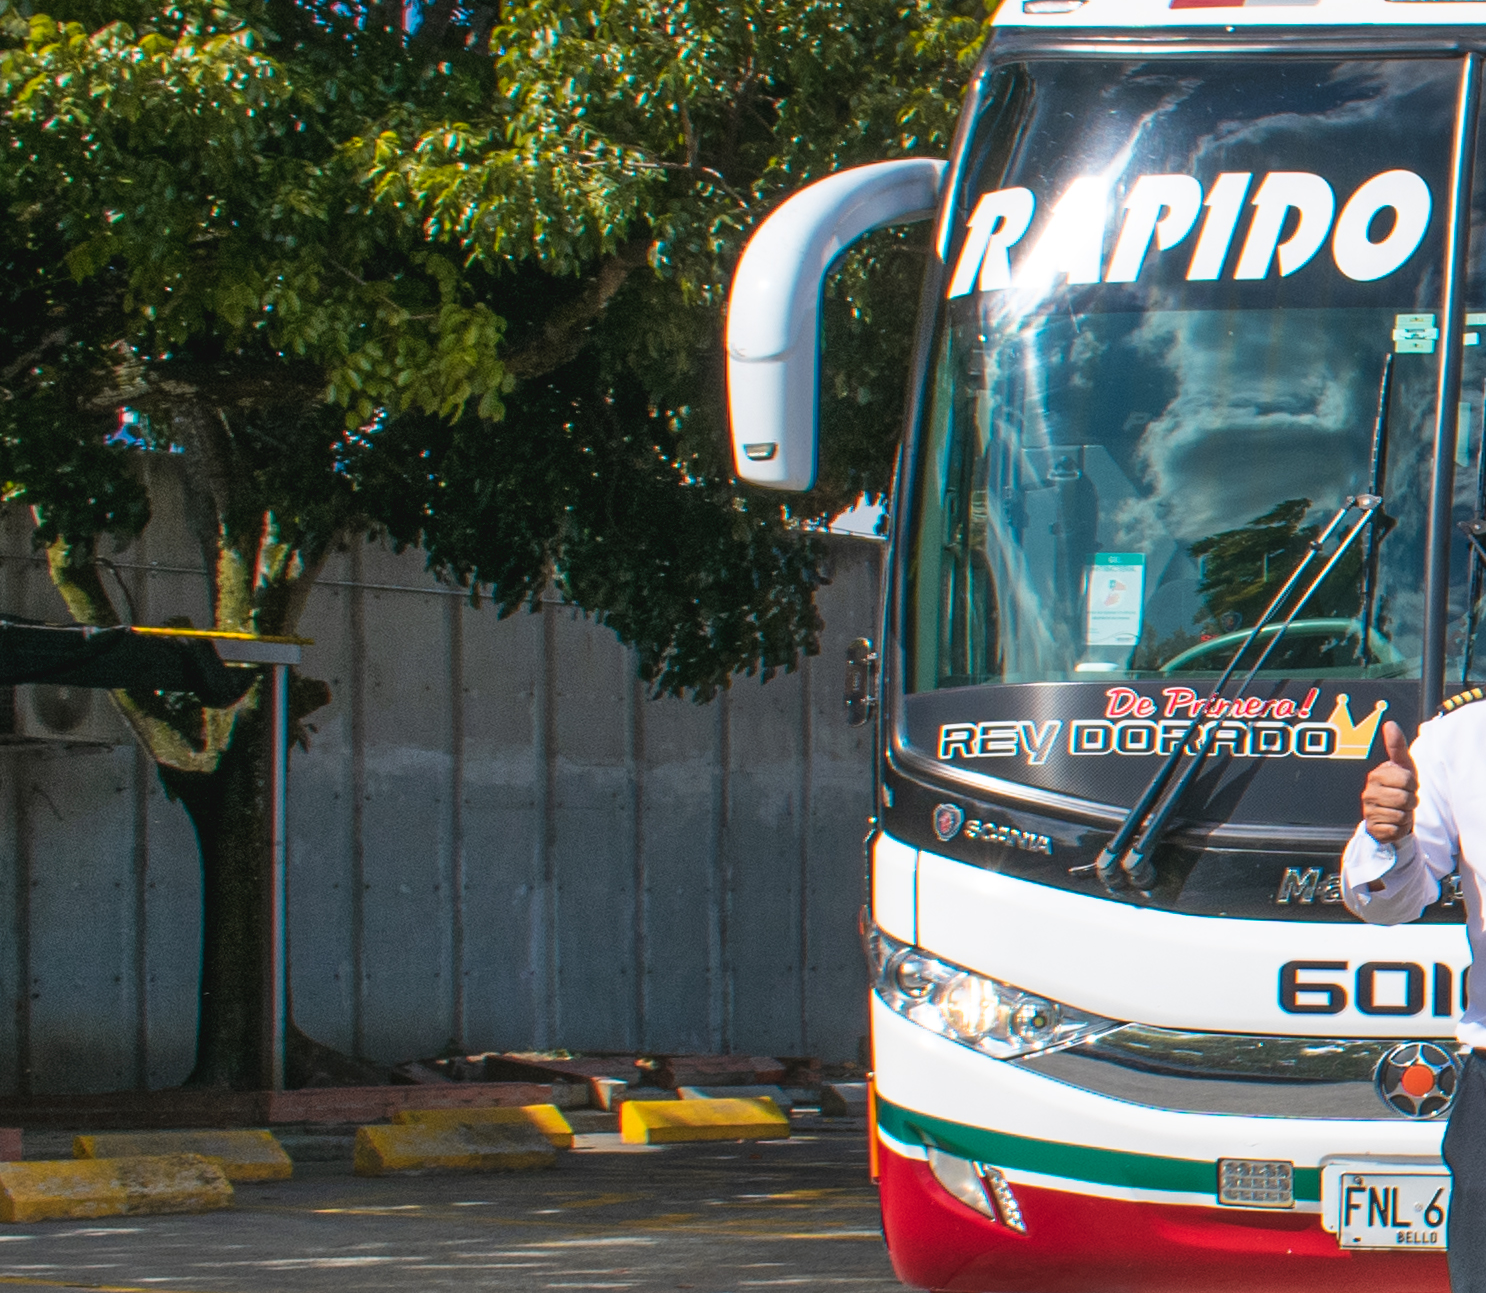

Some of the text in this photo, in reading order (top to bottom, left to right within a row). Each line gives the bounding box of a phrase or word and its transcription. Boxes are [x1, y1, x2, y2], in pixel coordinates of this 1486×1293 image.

[947, 169, 1433, 299] RAPIDO
[1106, 687, 1320, 718] De Primera!
[938, 719, 1341, 766] REY DORADO
[1278, 960, 1472, 1017] 601
[1345, 1187, 1412, 1227] FNL
[1397, 1231, 1438, 1244] BELLO
